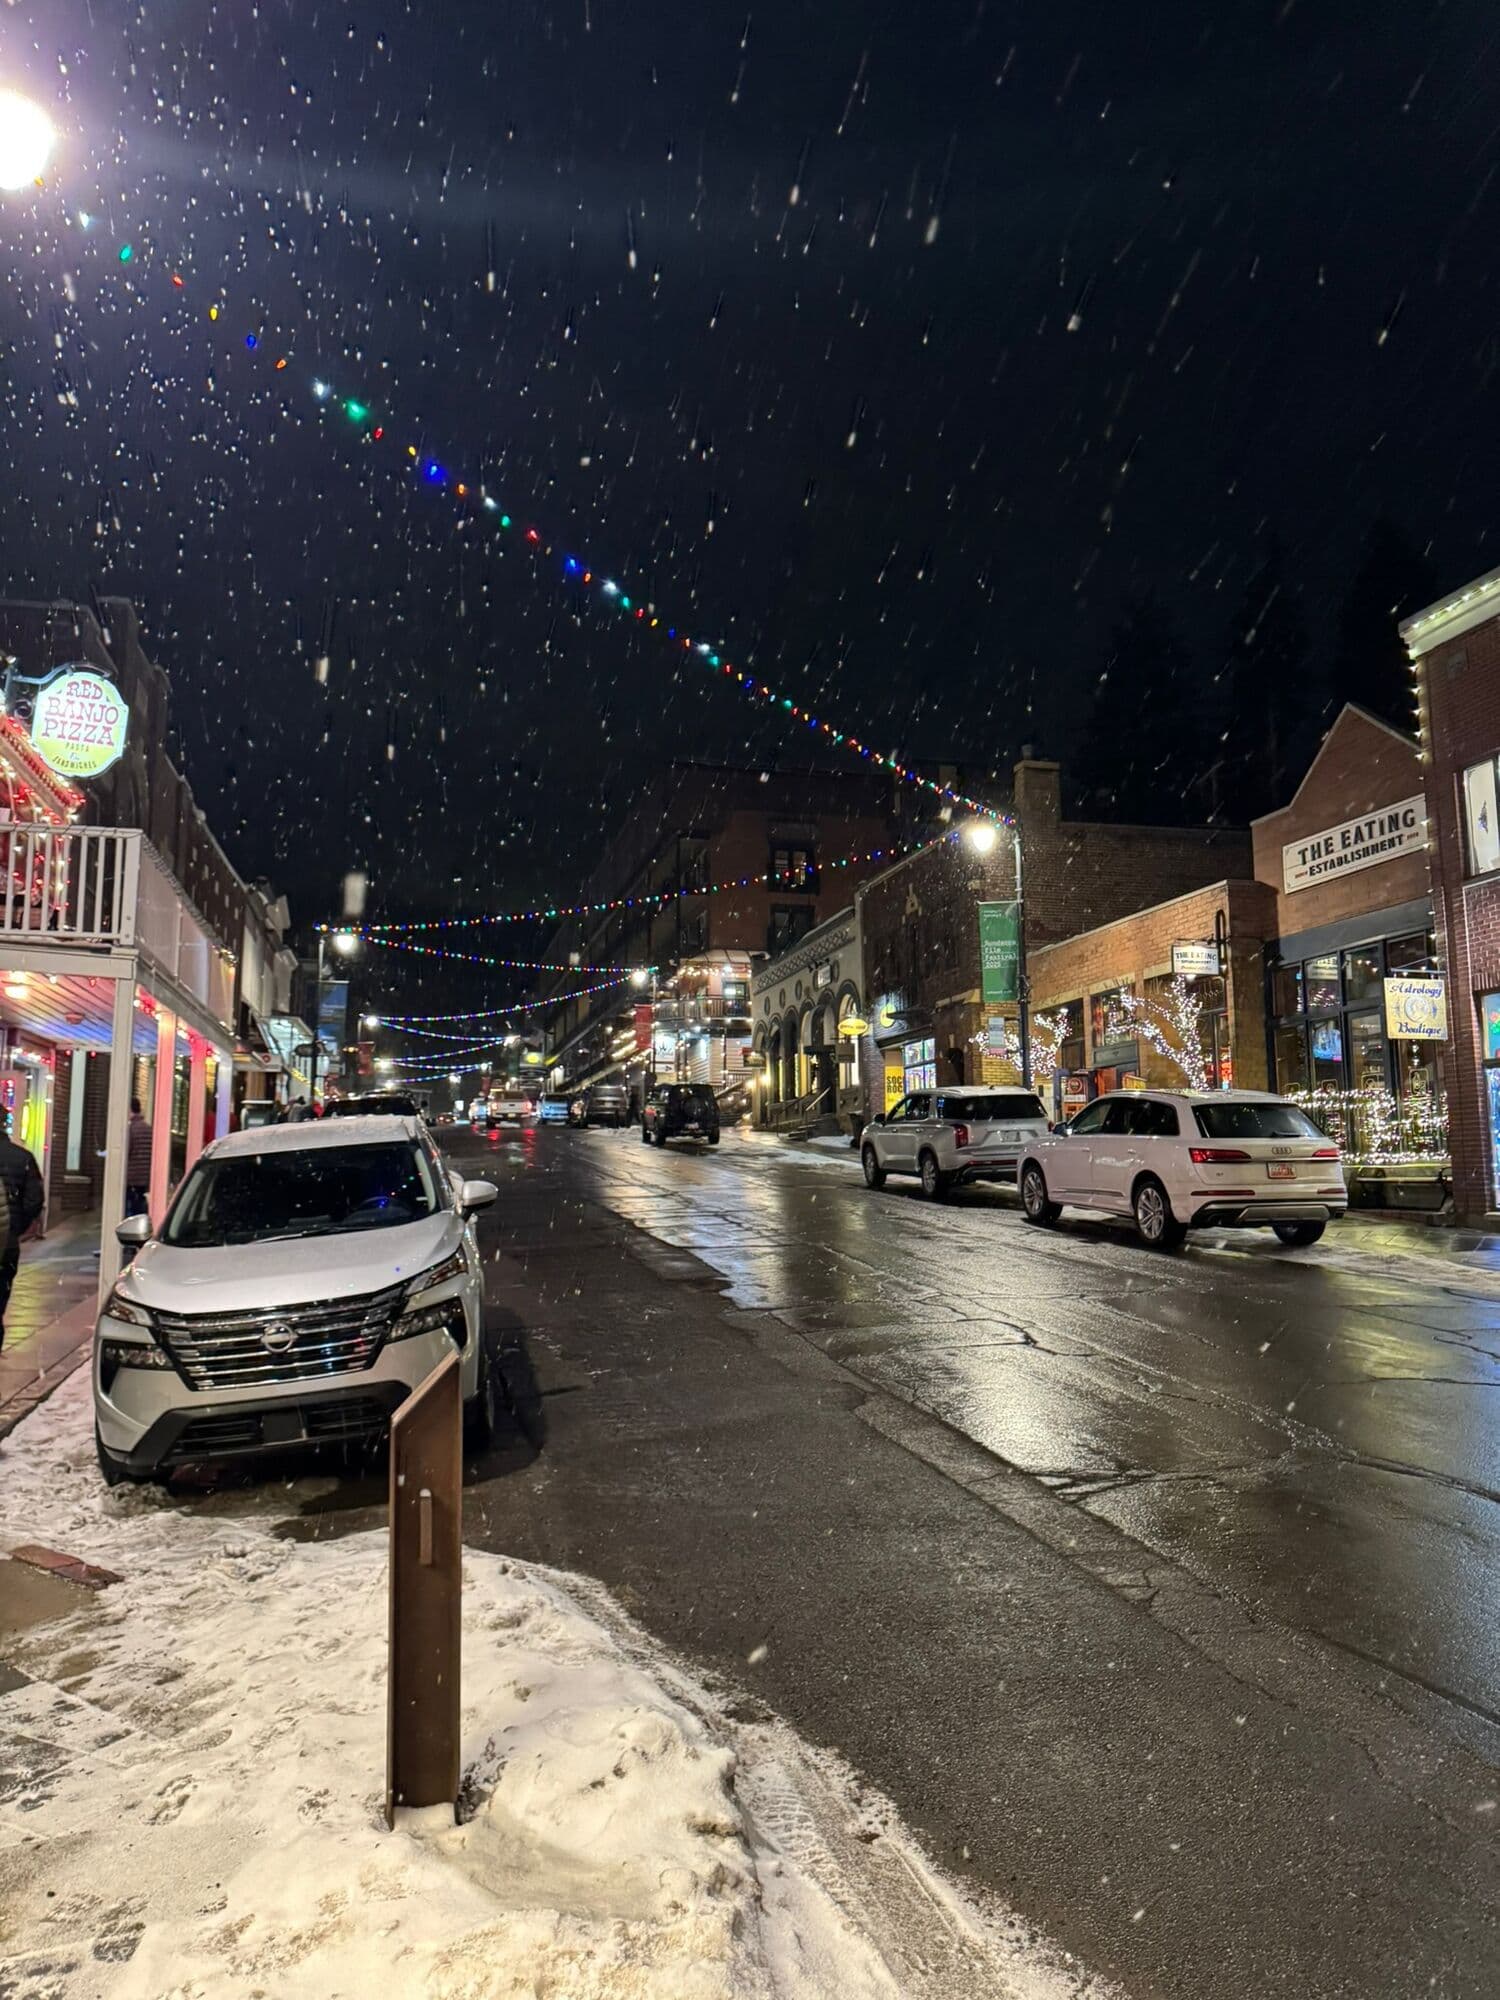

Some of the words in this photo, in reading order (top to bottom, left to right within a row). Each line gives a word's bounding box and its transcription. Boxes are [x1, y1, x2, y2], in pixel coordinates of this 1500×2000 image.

[66, 680, 103, 700] RED
[45, 696, 119, 725] BANJO
[42, 718, 114, 746] PIZZA
[65, 743, 89, 752] PASTA
[1298, 837, 1333, 866] THE
[1341, 808, 1415, 849] EATING
[1309, 834, 1404, 876] ESTABLISHMENT
[1389, 982, 1442, 998] Astrology
[1395, 1021, 1442, 1037] Boutique
